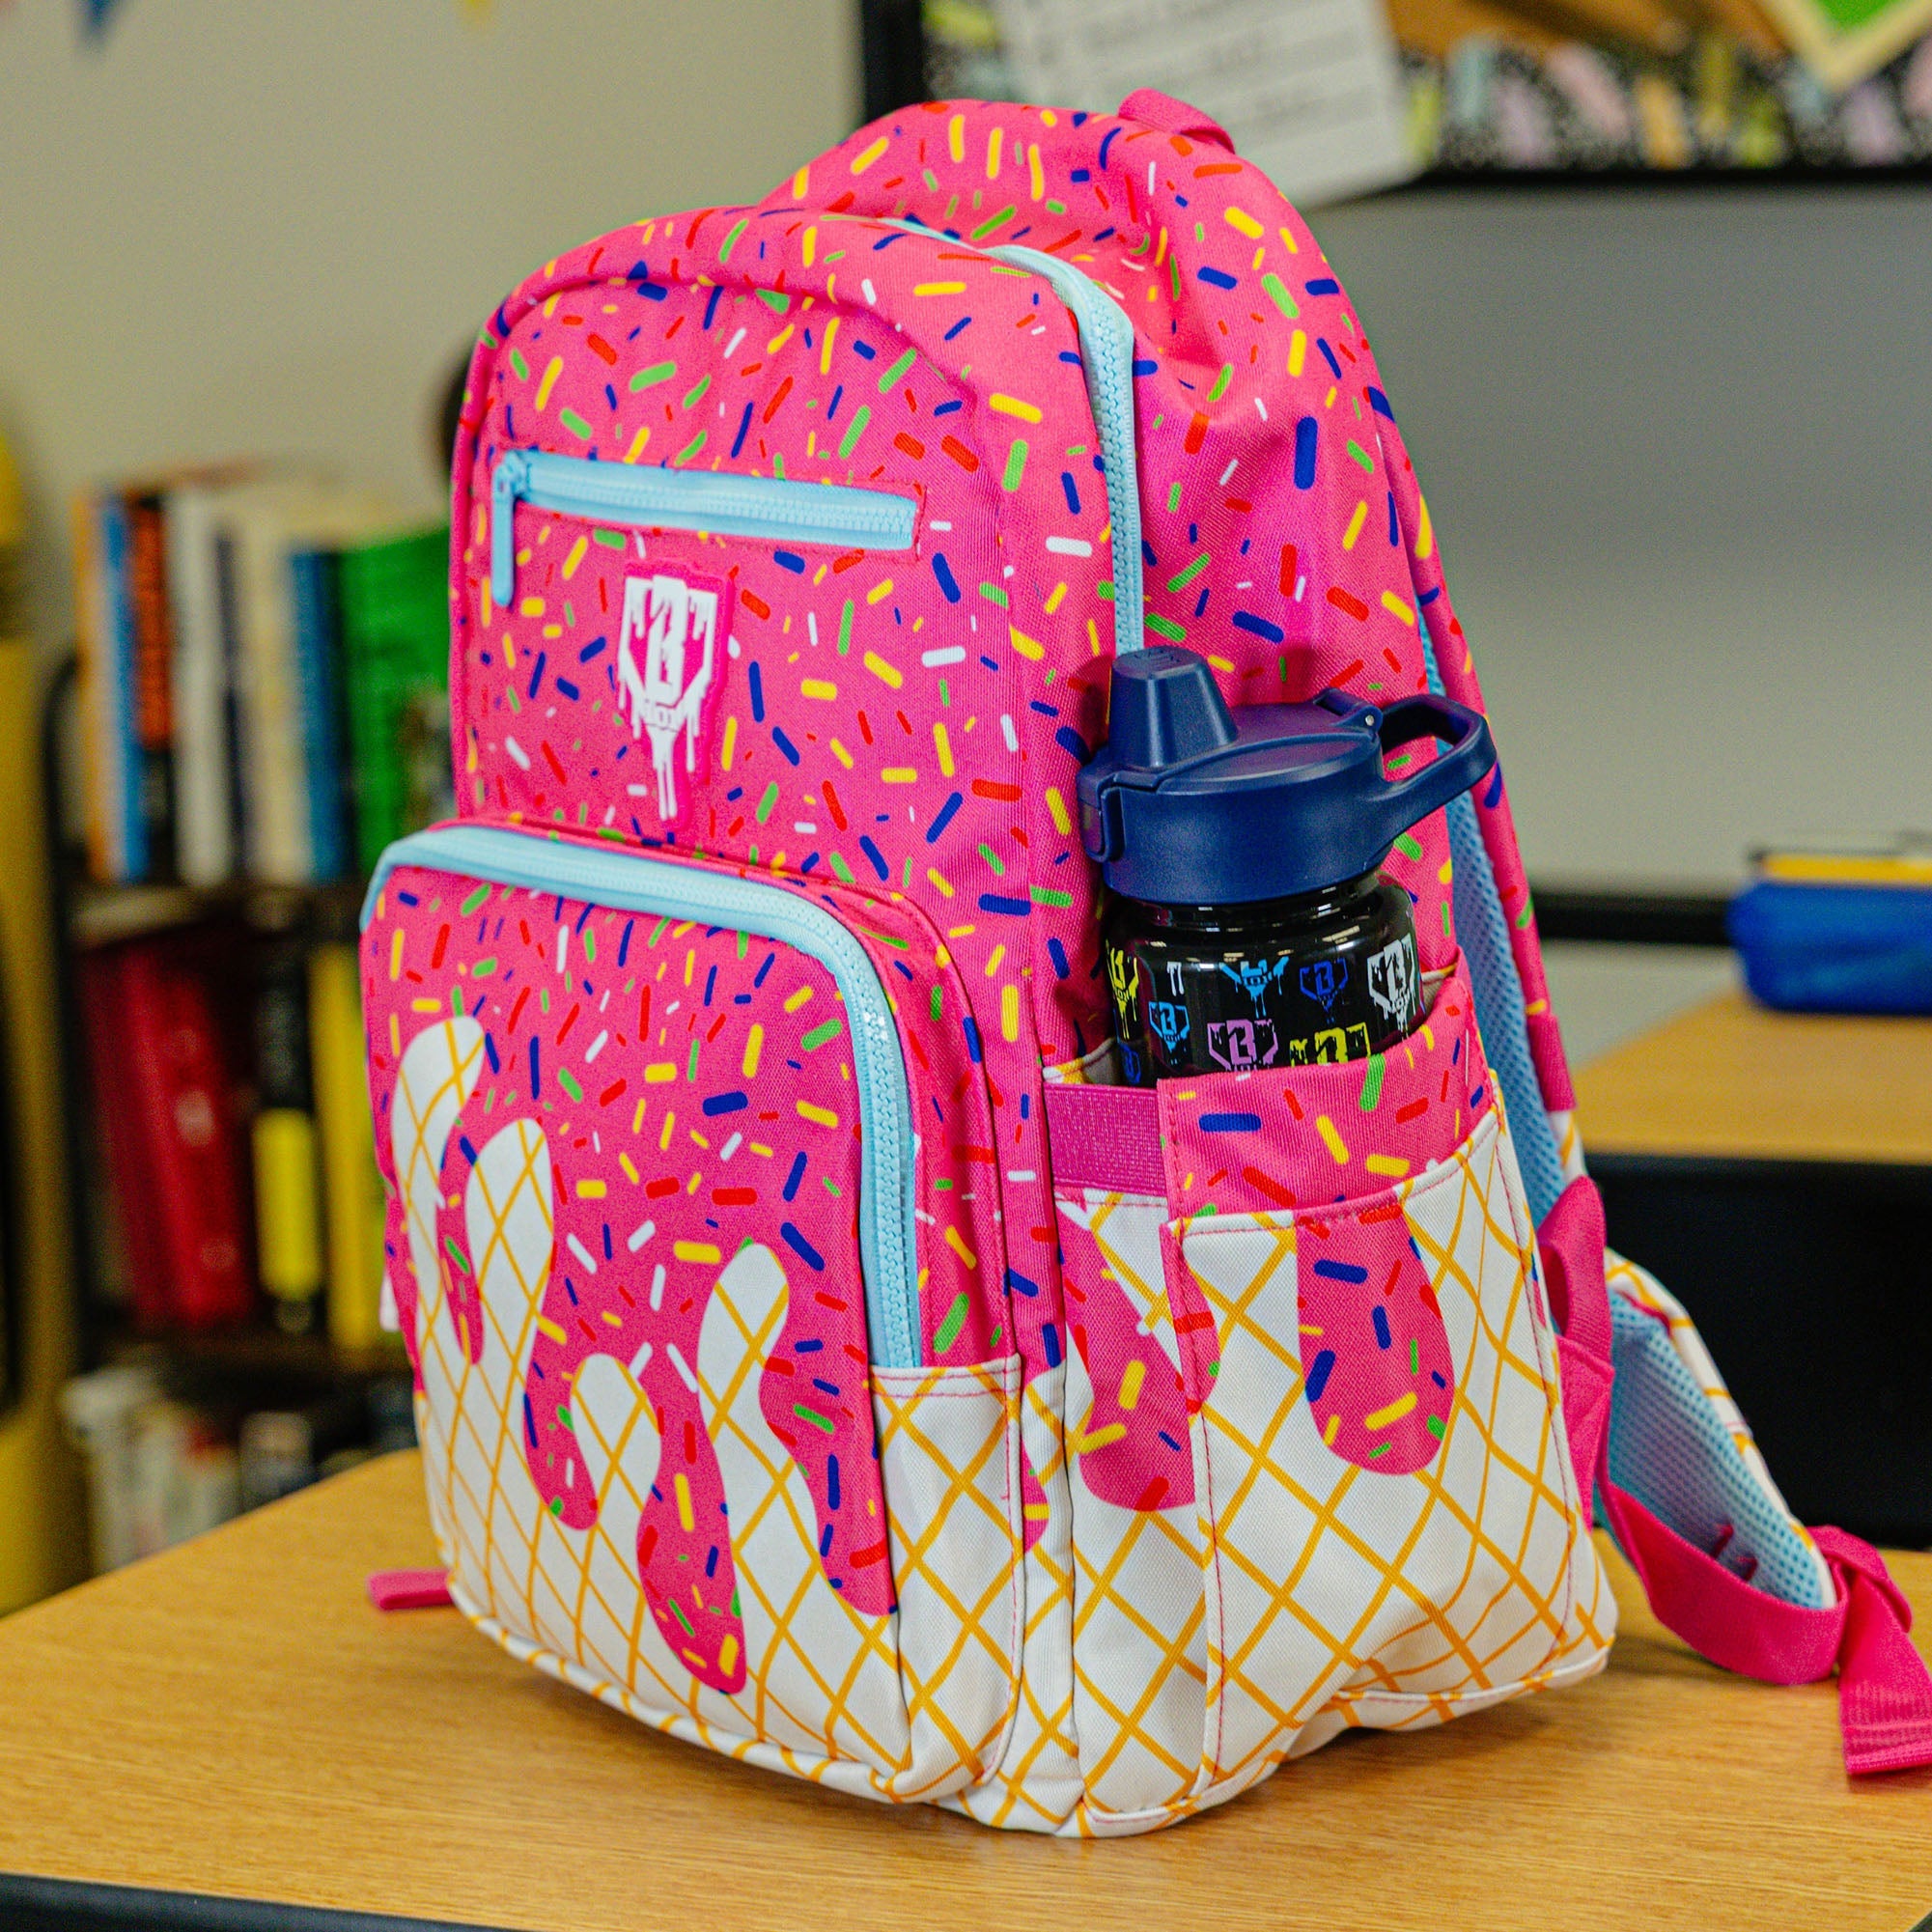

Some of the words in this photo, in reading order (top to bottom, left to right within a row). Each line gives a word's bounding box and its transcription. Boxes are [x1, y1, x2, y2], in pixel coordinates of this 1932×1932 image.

[645, 575, 688, 707] B
[1314, 961, 1334, 994] B
[1159, 1001, 1177, 1036] B
[1226, 1019, 1257, 1065] B
